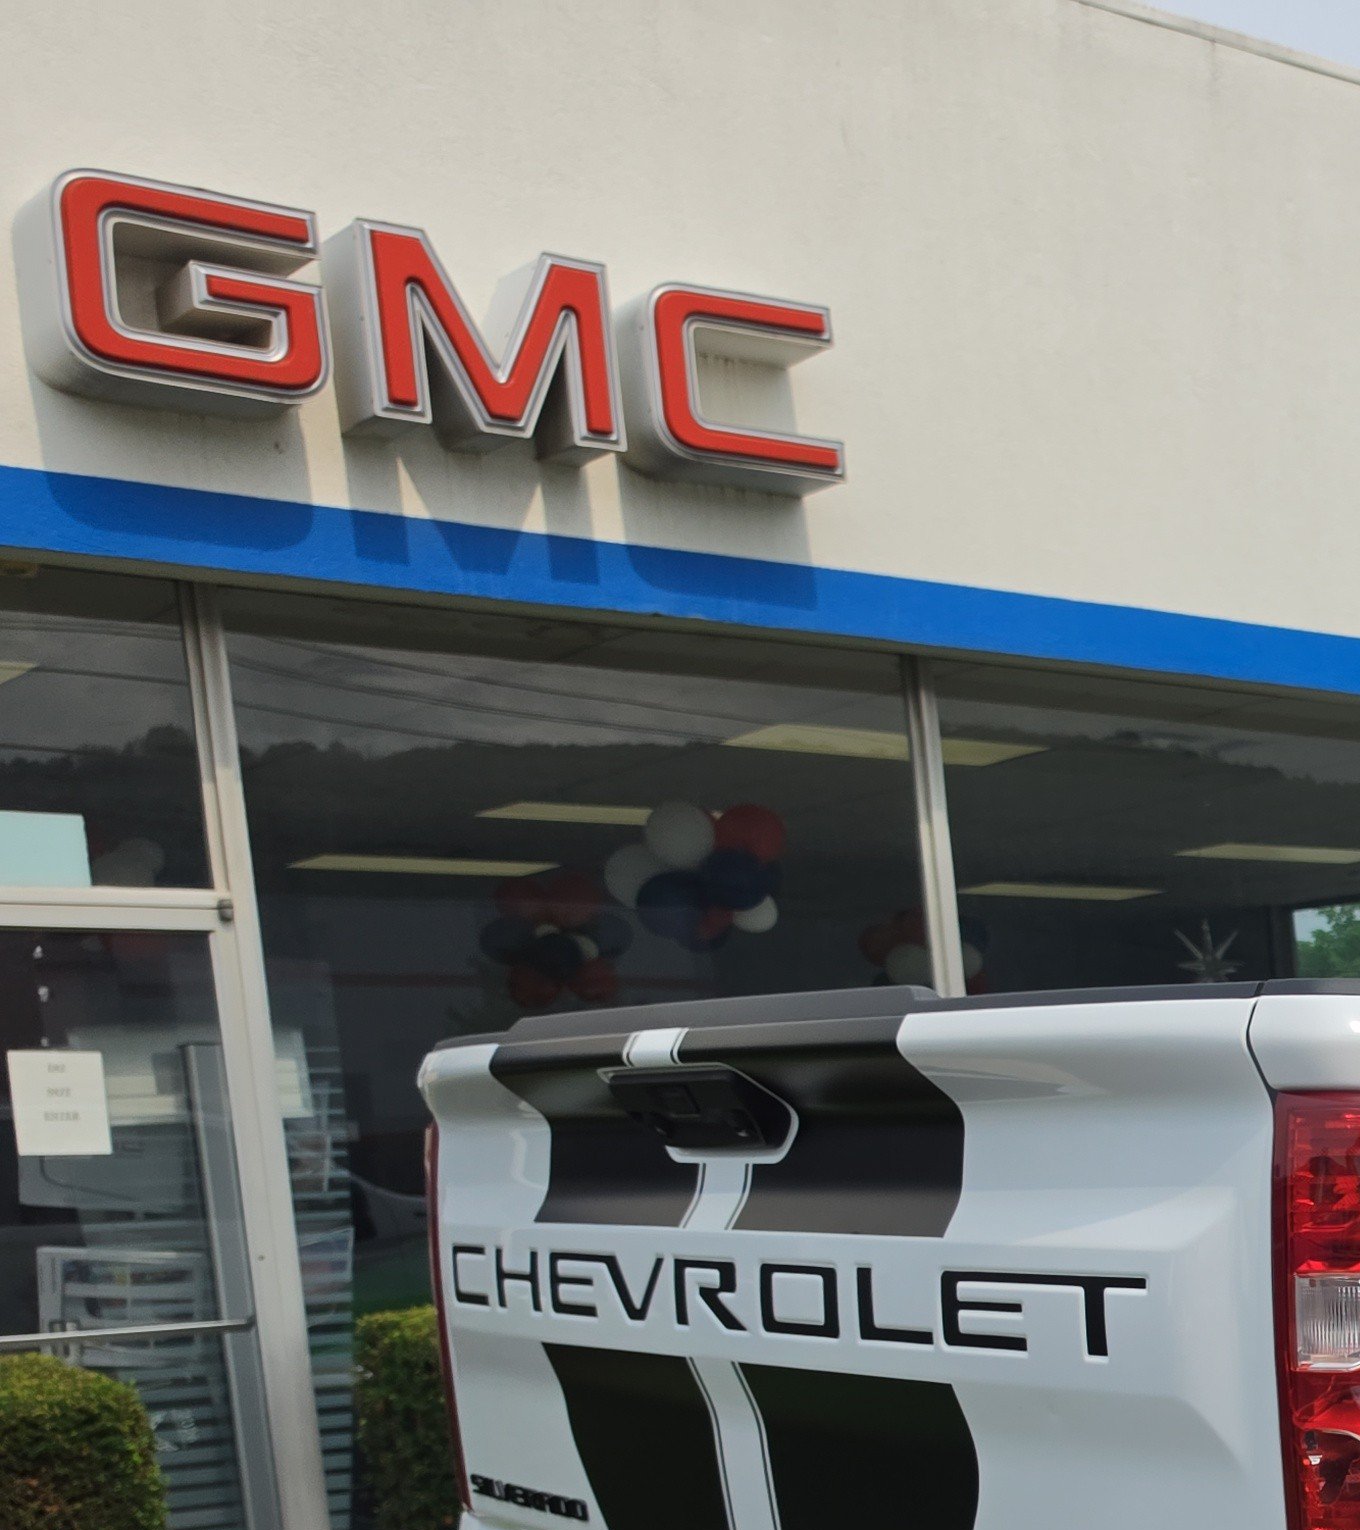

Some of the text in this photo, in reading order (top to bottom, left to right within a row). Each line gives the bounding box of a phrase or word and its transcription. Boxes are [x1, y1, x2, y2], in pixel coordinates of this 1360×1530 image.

[50, 166, 846, 488] GMC
[451, 1243, 1148, 1360] CHEVROLET
[469, 1473, 589, 1522] SILVERADO
